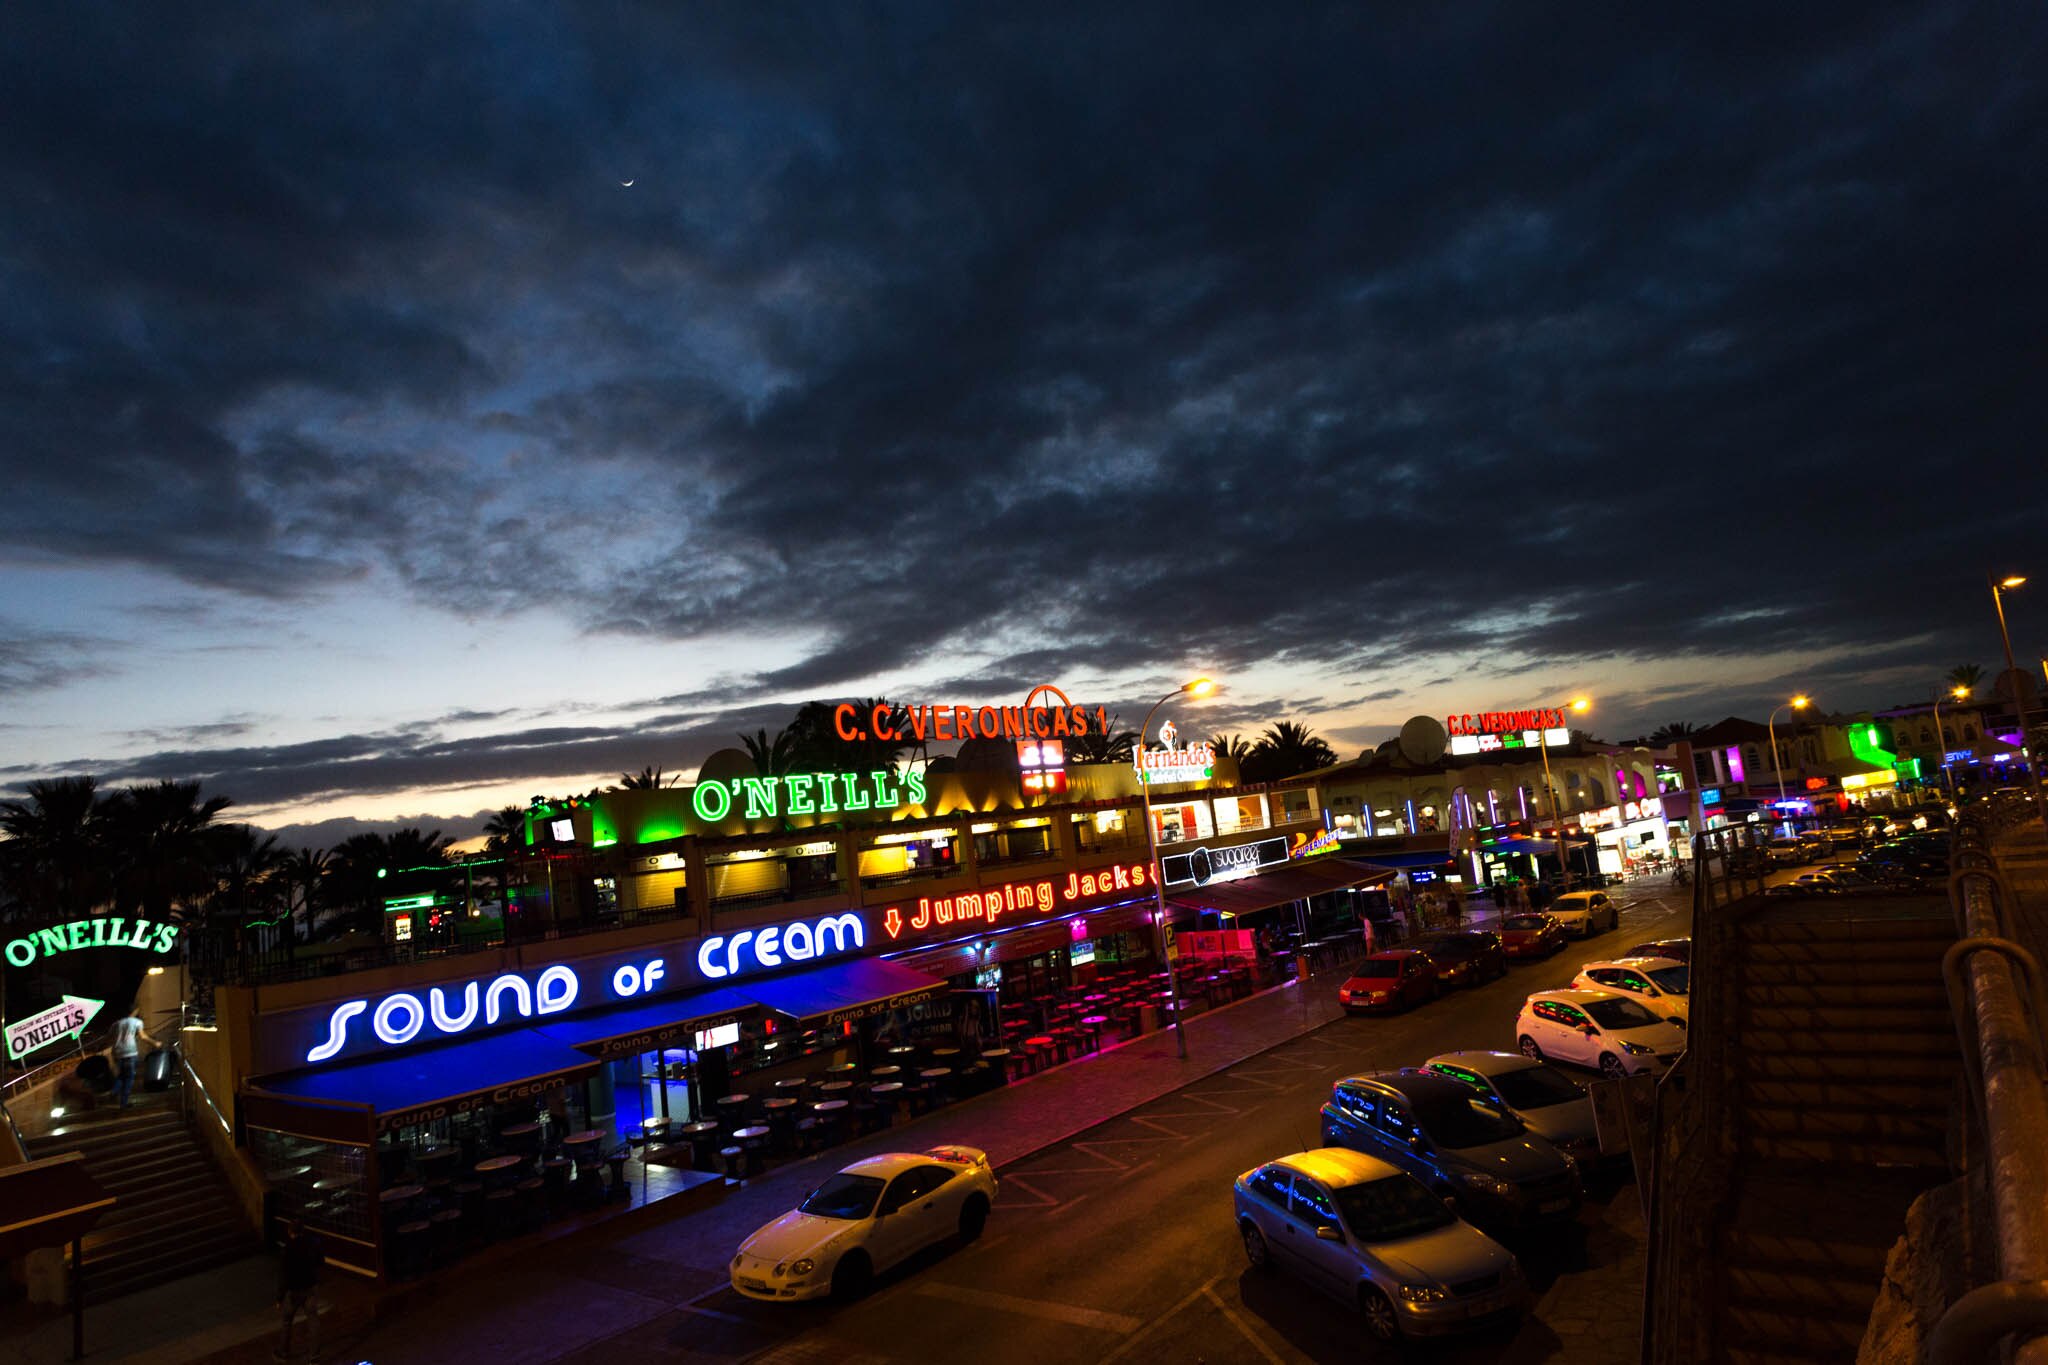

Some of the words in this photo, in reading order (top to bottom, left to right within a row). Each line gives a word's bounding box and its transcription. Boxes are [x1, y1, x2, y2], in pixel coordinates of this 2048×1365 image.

[906, 705, 1088, 740] VERONICAS
[1096, 706, 1107, 736] 1
[1478, 709, 1556, 733] VERONICAS
[692, 770, 927, 821] O'NEILL'S
[911, 882, 1053, 929] Jumping
[1064, 865, 1144, 899] Jacks
[5, 917, 179, 967] O'NEILL'S
[307, 965, 578, 1062] SOUND
[613, 960, 664, 996] OF
[698, 913, 864, 978] CREAM
[11, 1009, 86, 1054] O'NEILL'S
